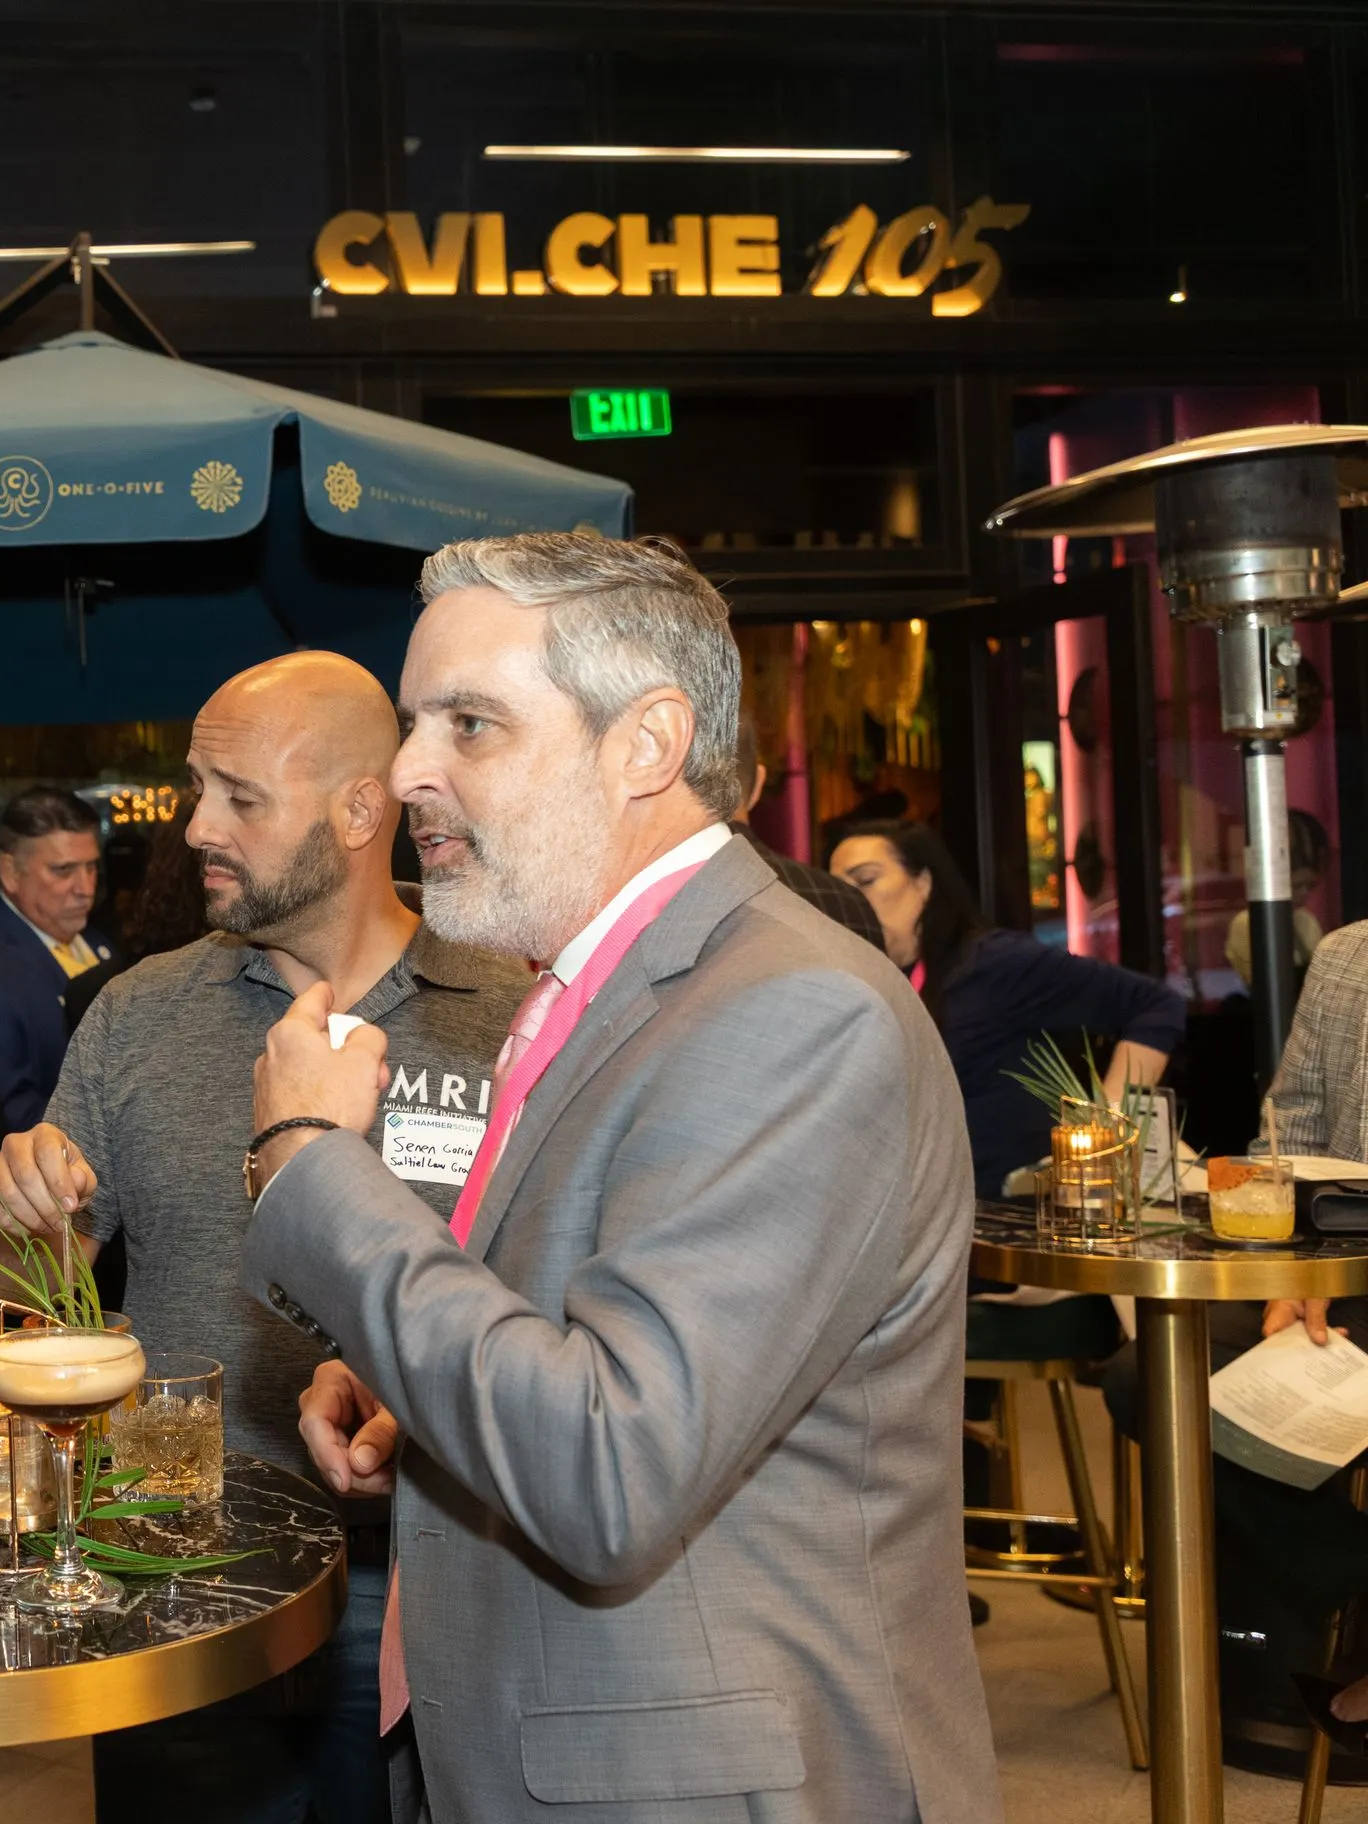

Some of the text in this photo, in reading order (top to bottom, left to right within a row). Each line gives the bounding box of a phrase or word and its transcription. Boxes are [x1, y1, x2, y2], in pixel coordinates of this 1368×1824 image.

[313, 196, 1030, 316] CVI.CHE 105
[589, 391, 653, 433] EXIT
[383, 1101, 413, 1113] MIAMI
[387, 1064, 491, 1114] MRI
[407, 1119, 483, 1134] CHAMBERSOUTH
